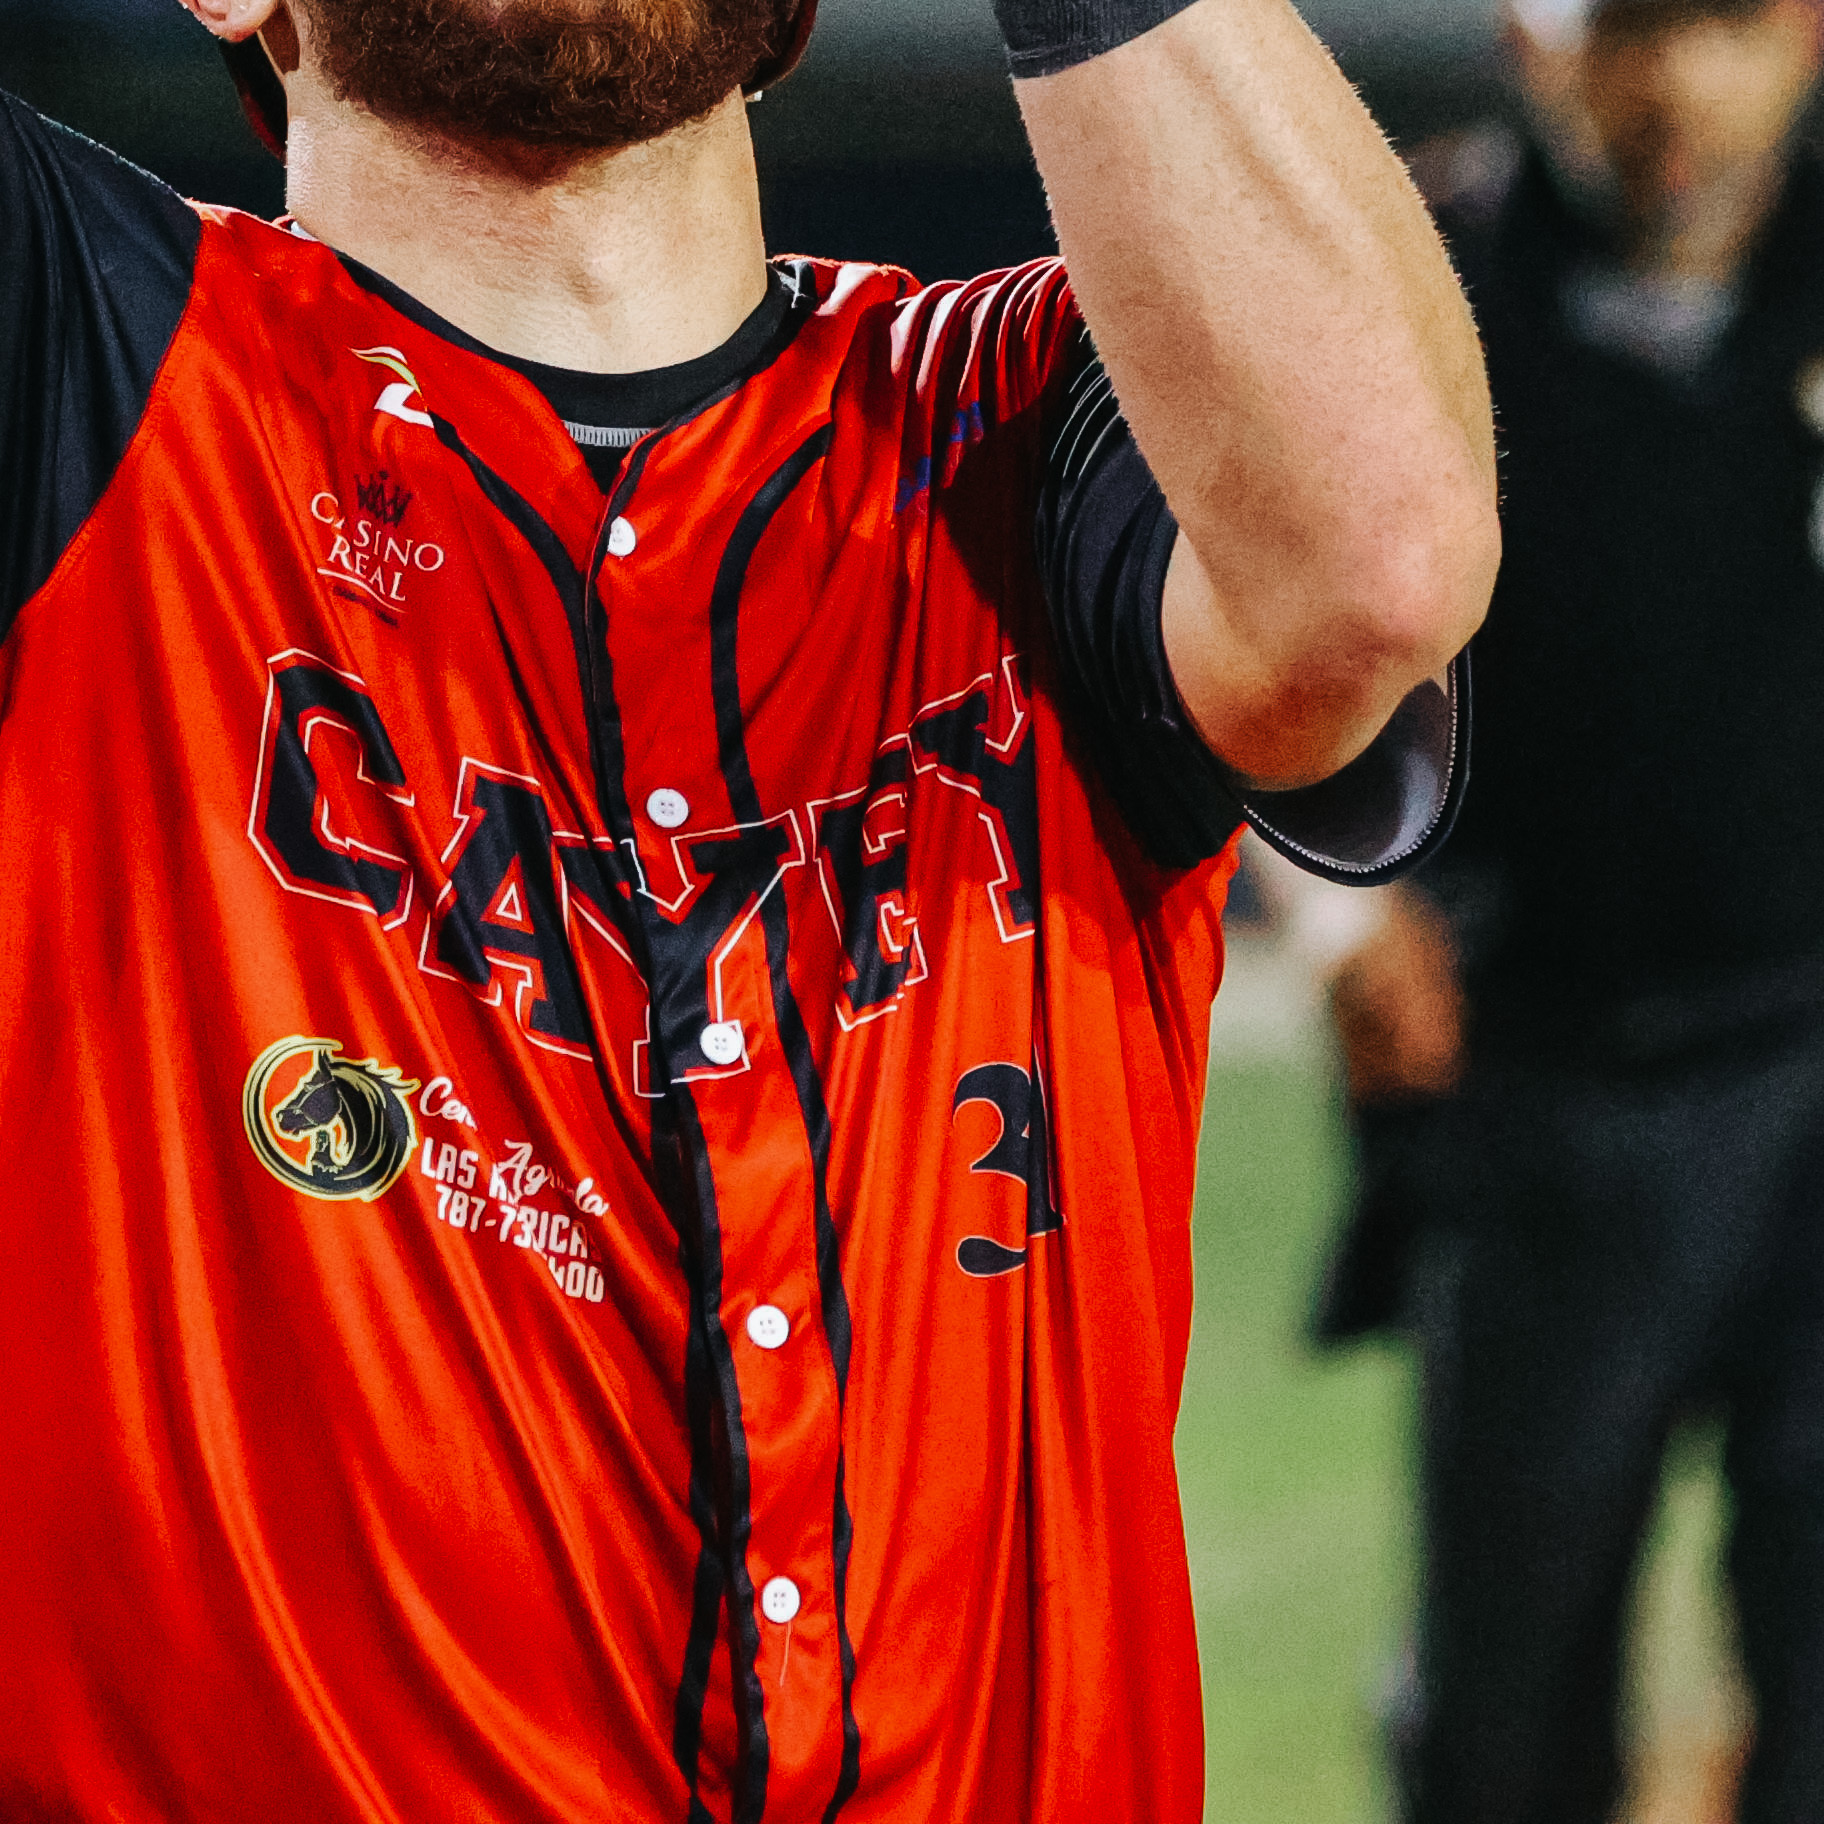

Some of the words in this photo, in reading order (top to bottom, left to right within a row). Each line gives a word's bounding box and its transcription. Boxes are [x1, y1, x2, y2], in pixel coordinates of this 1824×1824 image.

[311, 492, 444, 571] CSINO
[328, 535, 407, 601] REAL
[247, 648, 1037, 1098] CAYEY
[421, 1137, 479, 1190] LAS
